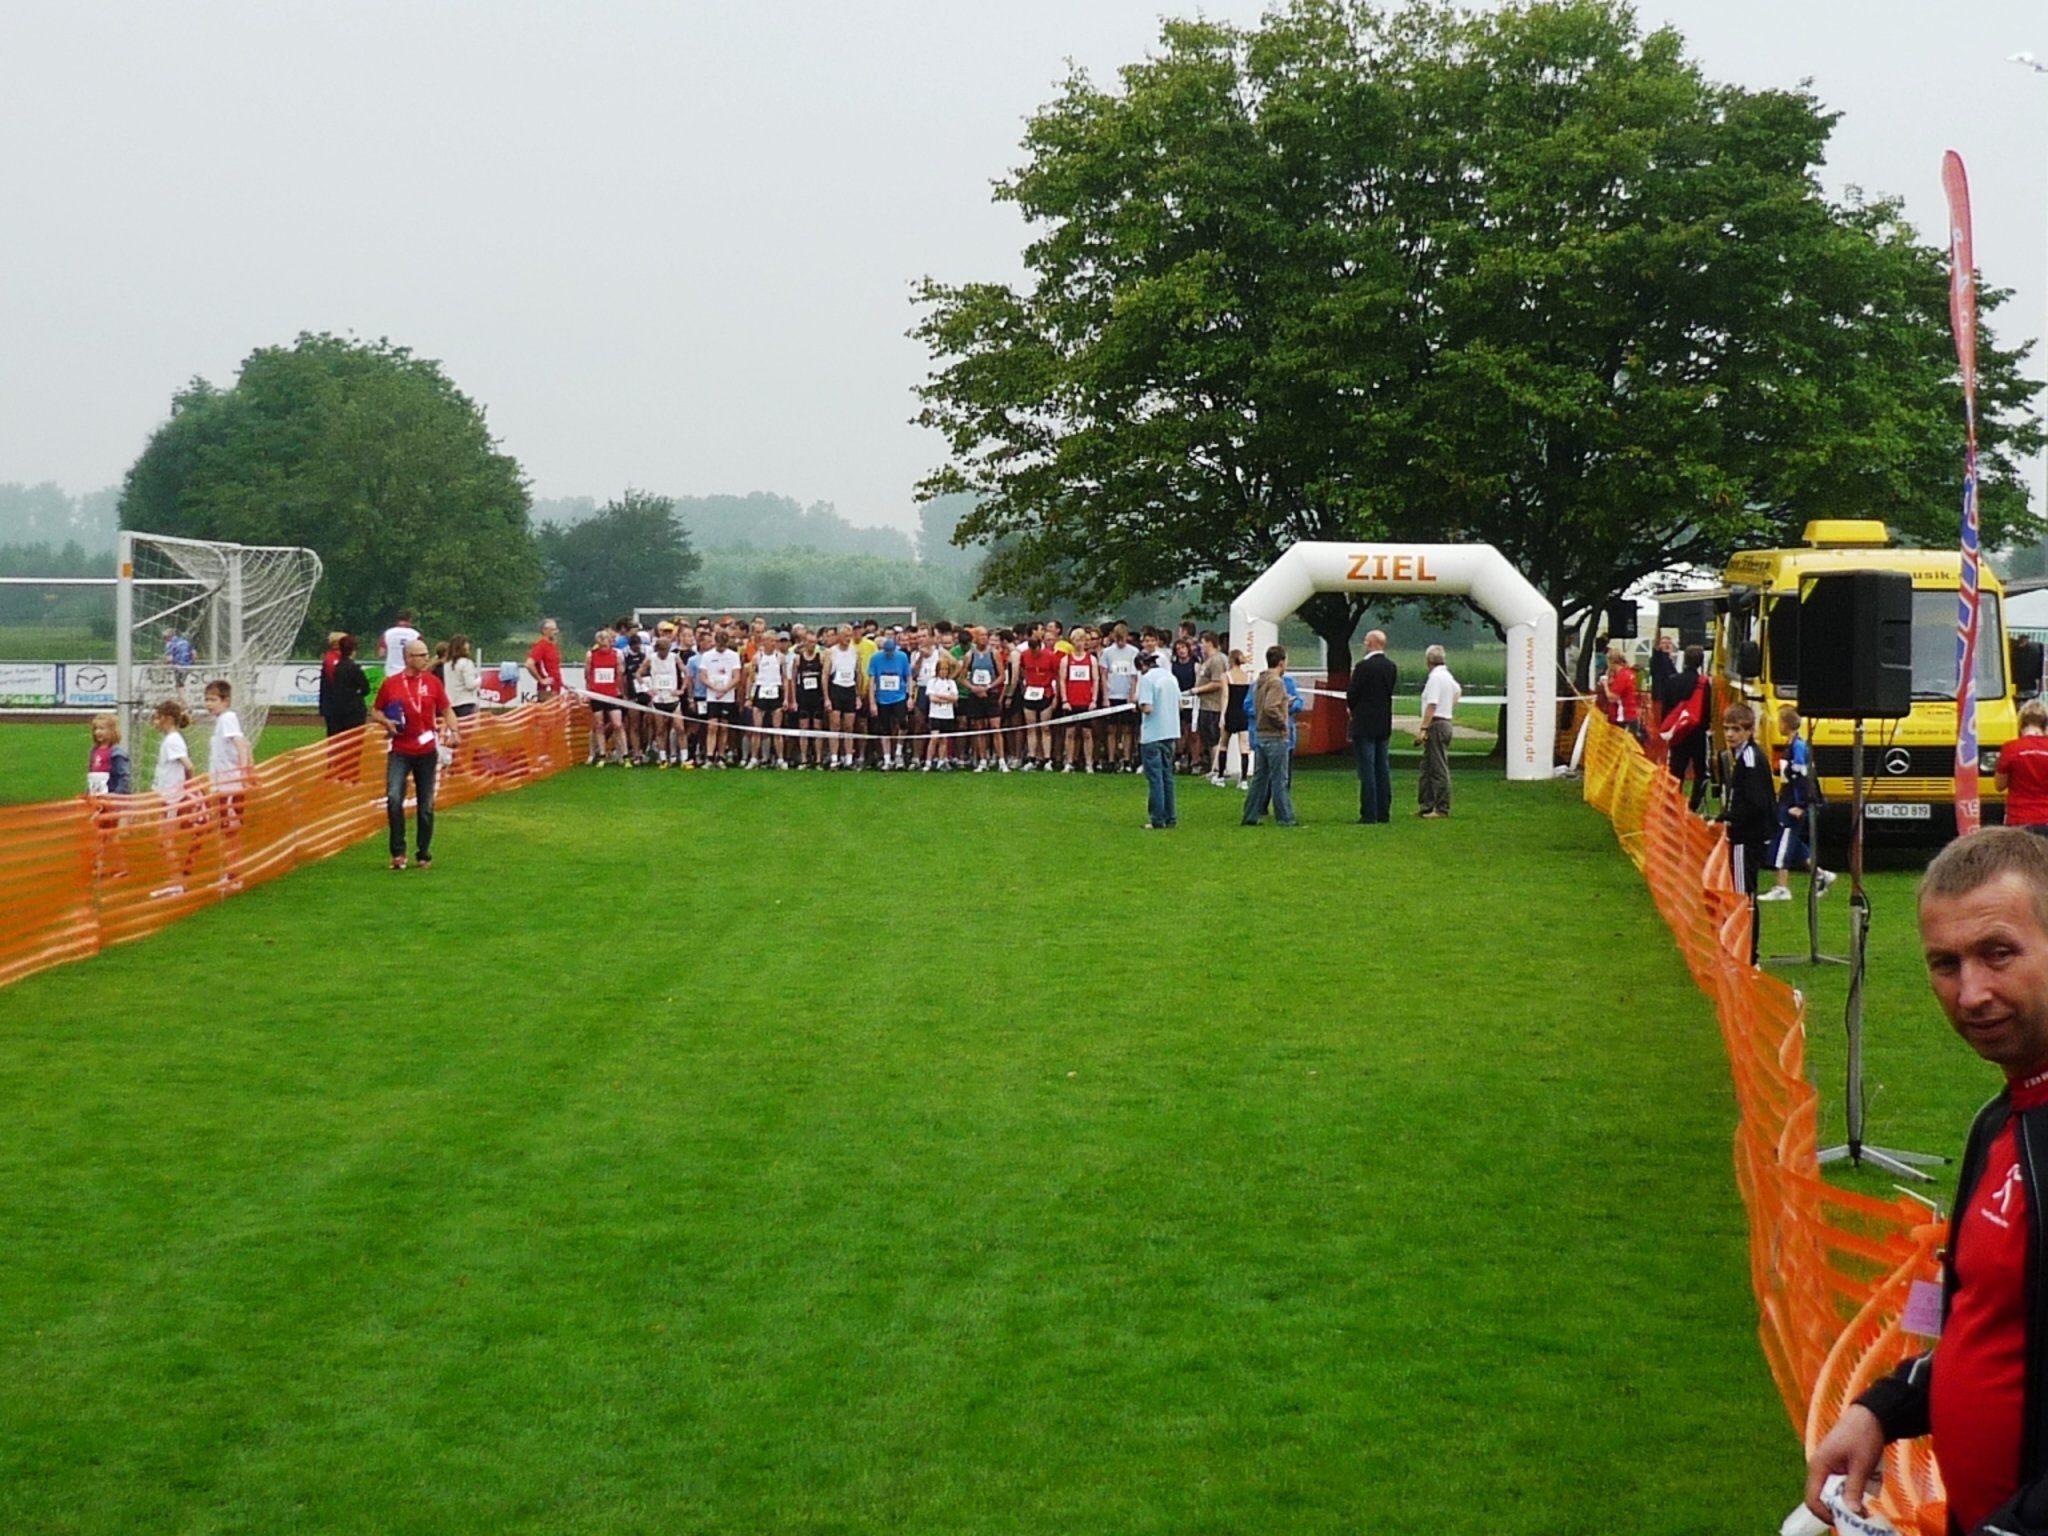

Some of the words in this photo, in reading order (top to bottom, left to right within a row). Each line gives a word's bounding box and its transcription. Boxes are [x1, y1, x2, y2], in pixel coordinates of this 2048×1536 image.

[1346, 554, 1438, 581] ZIEL
[1523, 636, 1536, 764] www.taf-timing.de
[1867, 805, 1884, 816] MG
